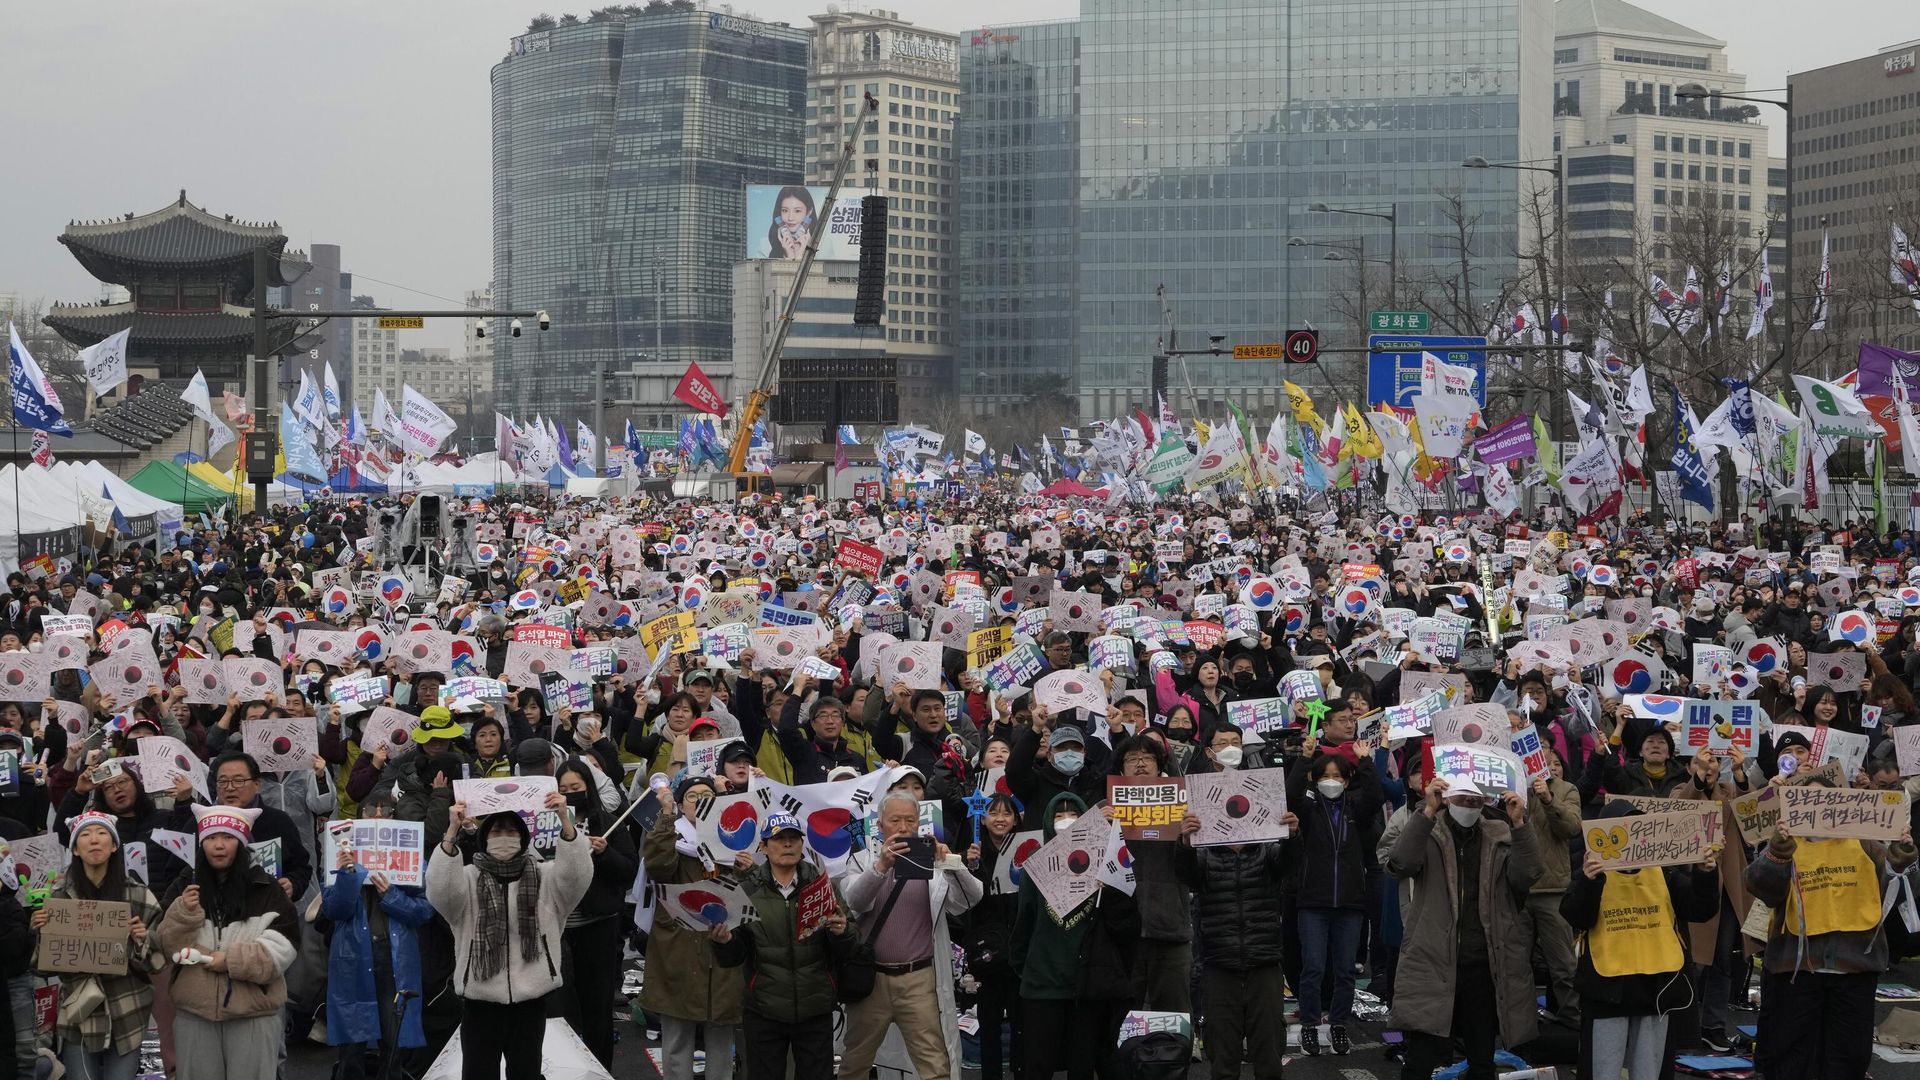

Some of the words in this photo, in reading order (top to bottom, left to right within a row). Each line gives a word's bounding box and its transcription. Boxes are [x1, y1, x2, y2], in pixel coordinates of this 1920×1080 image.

[892, 38, 957, 62] SOMERSET
[1884, 50, 1916, 72] 아주경제
[848, 235, 861, 245] ZE
[1236, 344, 1281, 358] 과속단속장비
[1293, 340, 1310, 354] 40
[689, 378, 719, 411] 진보당
[650, 616, 678, 635] 윤석열
[517, 630, 546, 639] 윤석열
[548, 631, 567, 641] 파면
[1102, 639, 1127, 654] 해체
[1436, 645, 1458, 658] 하라
[1008, 644, 1039, 669] 즉각
[1102, 652, 1130, 669] 하라
[591, 662, 612, 676] 파면
[1015, 656, 1044, 686] 파면
[1289, 672, 1315, 688] 즉각
[357, 688, 385, 702] 파면
[474, 688, 503, 699] 파면
[1291, 685, 1319, 700] 파면
[1254, 701, 1281, 717] 즉각
[1414, 692, 1443, 717] 즉각
[1256, 714, 1284, 733] 파면
[1440, 762, 1471, 772] 윤석열
[1472, 753, 1509, 772] 즉각
[1473, 768, 1509, 789] 파면
[1114, 786, 1177, 804] 탄핵인용
[1785, 789, 1880, 807] 일본군성노예제
[202, 816, 219, 829] 단결
[770, 815, 799, 828] 이재명
[1789, 809, 1817, 829] 문제
[355, 827, 420, 849] 민의힘
[1631, 818, 1674, 841] 우리가
[1623, 837, 1701, 864] 기억하겠습니다
[48, 907, 72, 925] 우리는
[109, 909, 129, 928] 만든
[1064, 909, 1085, 929] MOST
[50, 937, 115, 966] 말벌시민
[1149, 1015, 1181, 1034] 즉각
